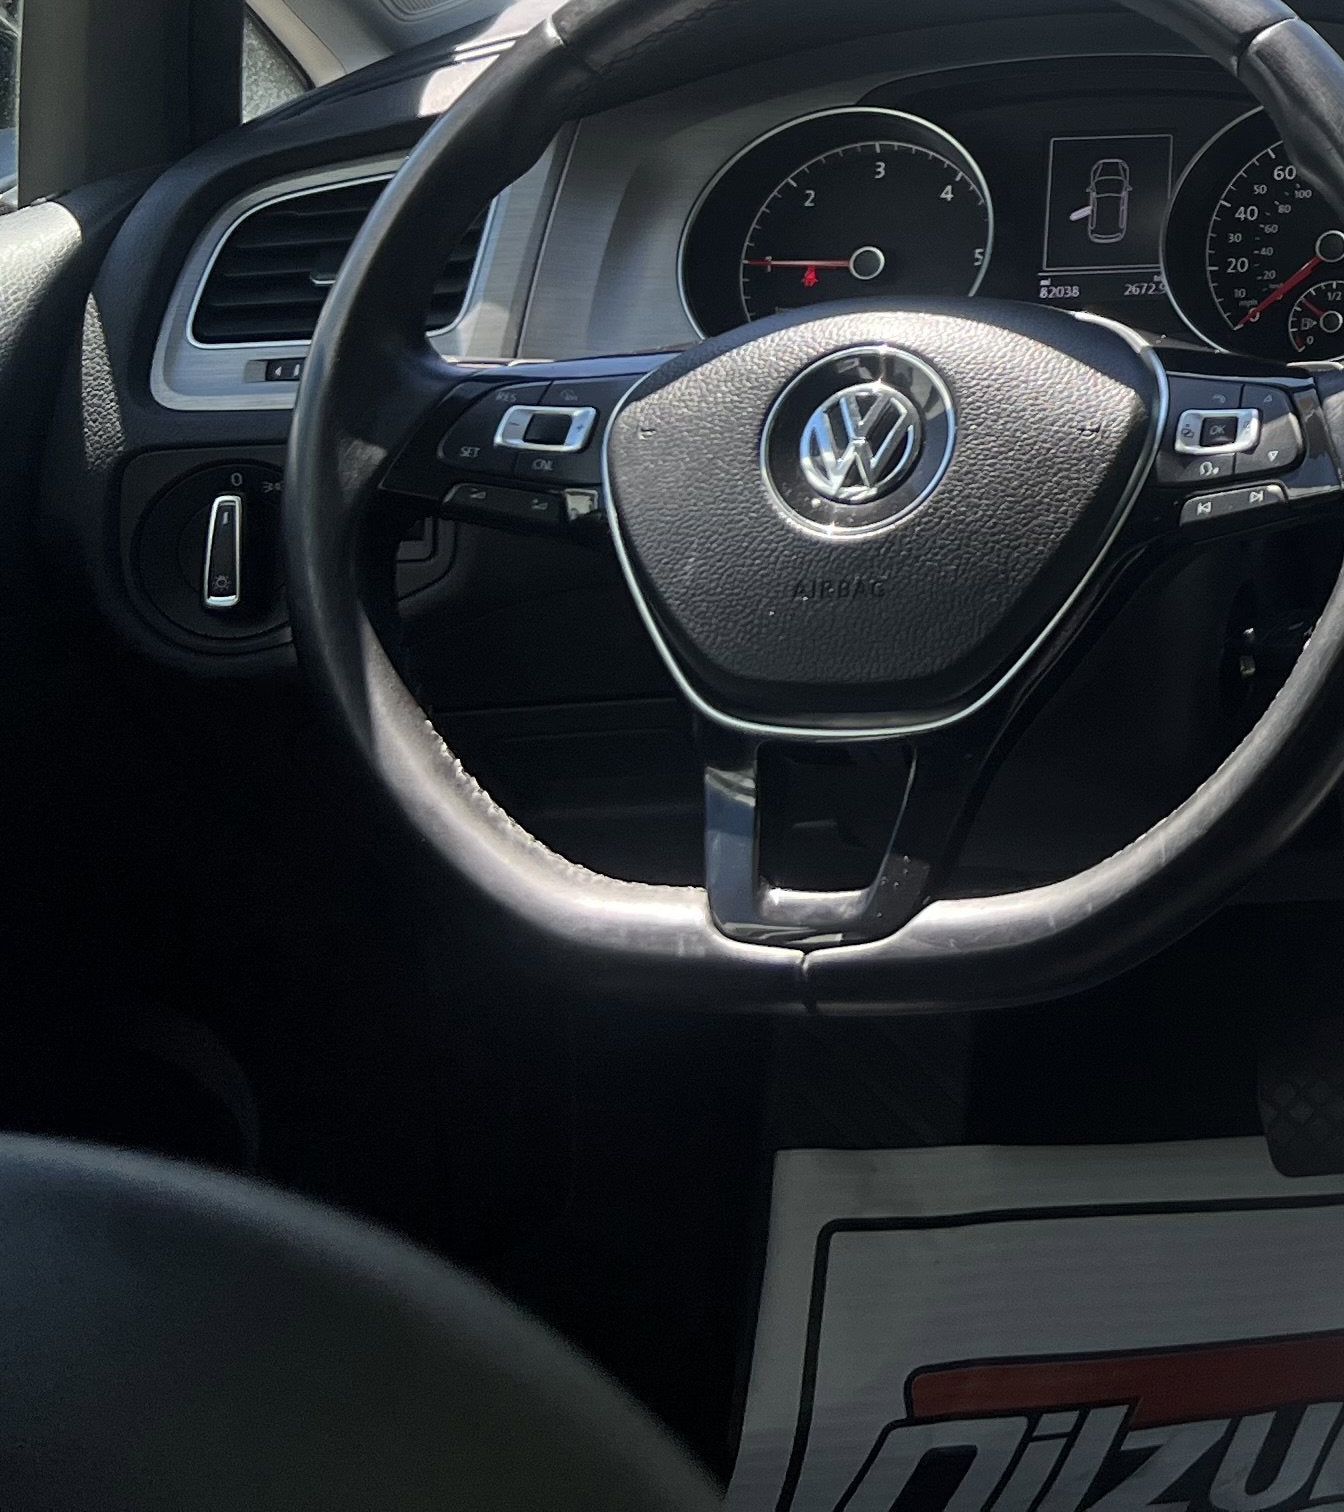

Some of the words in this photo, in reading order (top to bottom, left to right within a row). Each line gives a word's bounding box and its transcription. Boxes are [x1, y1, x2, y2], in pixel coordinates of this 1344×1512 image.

[874, 162, 885, 178] 3
[1273, 165, 1296, 180] 60
[940, 185, 954, 202] 4
[1253, 185, 1267, 194] 50
[1294, 190, 1312, 199] 100
[803, 190, 816, 206] 2
[1235, 206, 1258, 220] 40
[1278, 204, 1291, 213] 80
[1264, 224, 1278, 233] 60
[1228, 233, 1242, 243] 30
[973, 248, 984, 266] 5
[1260, 247, 1273, 256] 40
[1226, 258, 1249, 272] 20
[1263, 271, 1276, 279] 20
[1039, 286, 1080, 299] 82038
[1234, 289, 1246, 297] 10
[1327, 291, 1342, 301] 1/2
[1306, 335, 1314, 345] 0
[459, 446, 481, 458] SET
[531, 459, 553, 471] CNL
[791, 577, 887, 599] AIRBAG
